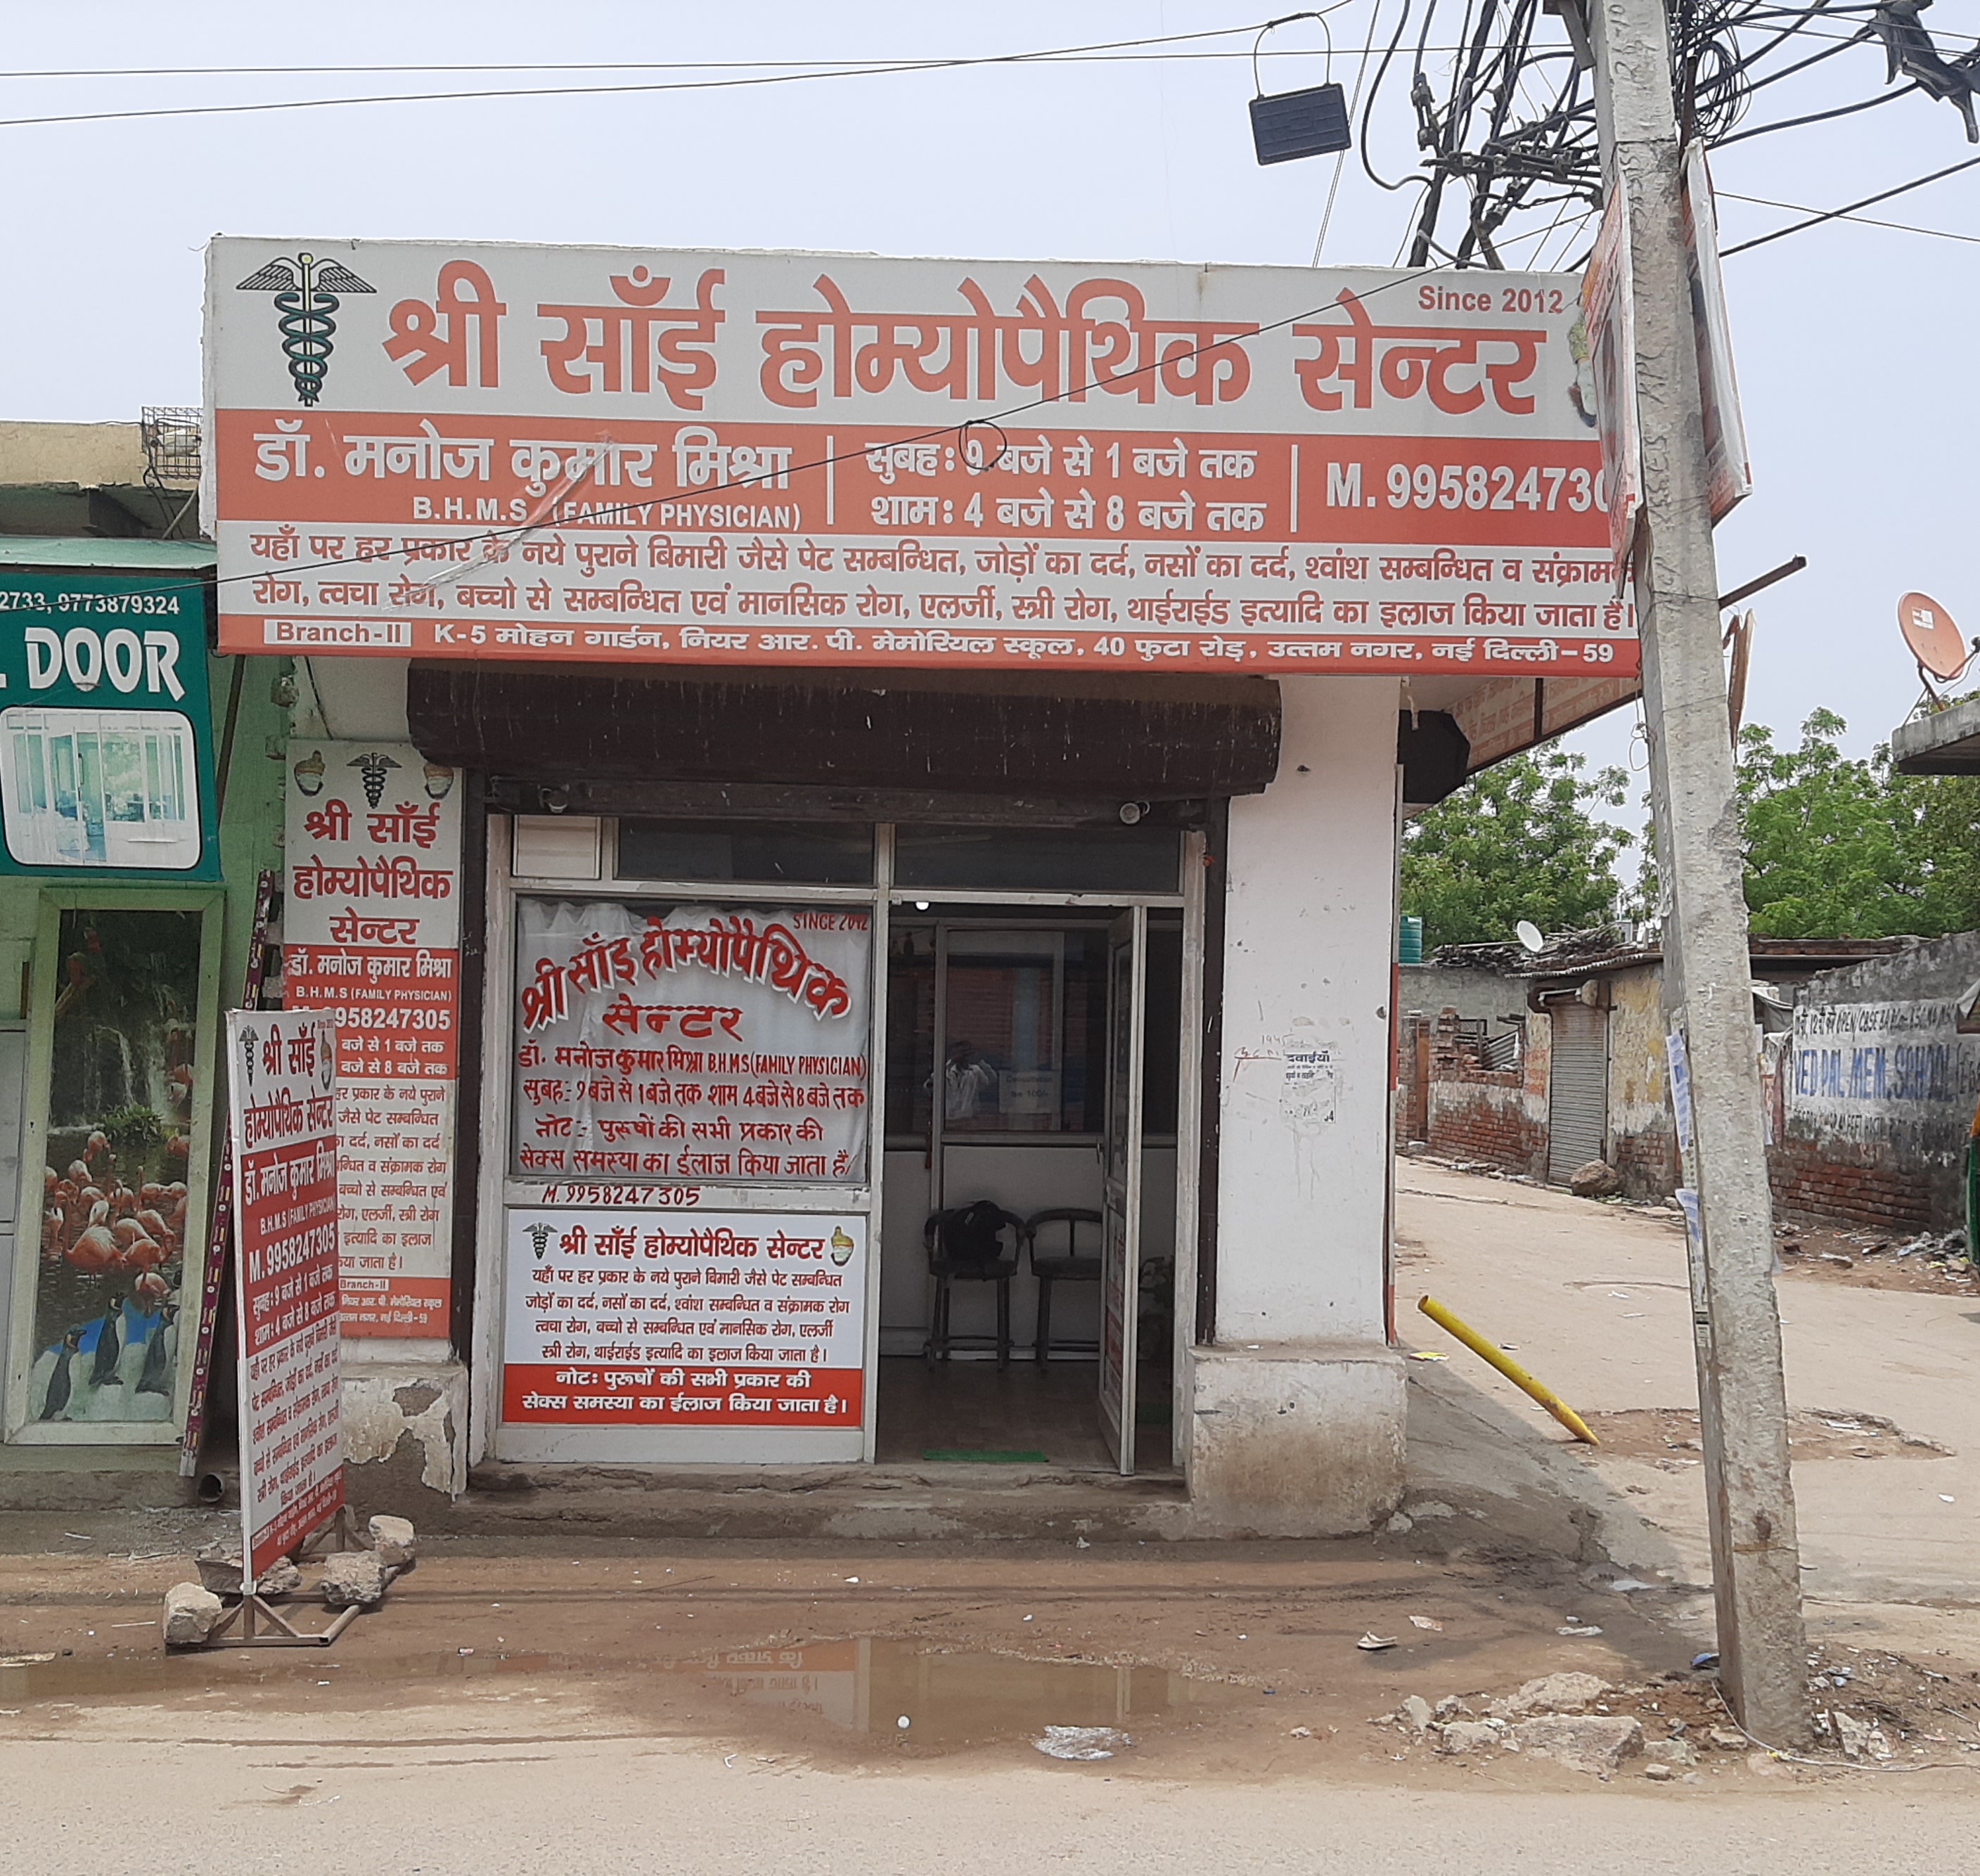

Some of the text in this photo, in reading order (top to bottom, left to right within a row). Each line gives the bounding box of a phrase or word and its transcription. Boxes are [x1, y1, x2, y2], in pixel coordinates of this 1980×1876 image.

[1418, 285, 1562, 314] Since 2012
[383, 261, 505, 387] श्री
[756, 276, 1259, 408] होम्योपैथिक
[1292, 287, 1545, 414] सेन्टर
[252, 419, 792, 502] डॉ. मनोज कुमार मिश्रा
[963, 439, 986, 475] 9
[992, 435, 1052, 475] बजे
[1062, 436, 1093, 477] से
[1105, 442, 1119, 478] 1
[1131, 438, 1188, 478] बजे
[1197, 450, 1256, 479] तक
[1326, 463, 1375, 507] M.
[1386, 460, 1611, 513] 995824730
[412, 496, 799, 532] B.H.M.S (FAMILY PHYSICIAN)
[963, 492, 984, 527] 4
[995, 488, 1054, 528] बजे
[1063, 489, 1095, 529] से
[1106, 495, 1124, 532] 8
[1137, 491, 1195, 531] बजे
[1205, 502, 1266, 532] तक
[249, 525, 298, 561] यहाँ
[309, 537, 345, 560] पर
[354, 537, 390, 563] हर
[401, 539, 471, 564] प्रकार
[522, 534, 565, 565] नये
[574, 537, 637, 577] पुराने
[648, 534, 726, 569] बिमारी
[737, 538, 787, 570] जैसे
[797, 540, 832, 571] पेट
[842, 539, 965, 573] सम्बन्धित,
[1045, 552, 1079, 574] का
[1091, 544, 1134, 576] दर्द,
[1145, 547, 1200, 577] नसों
[1206, 555, 1241, 576] का
[1250, 546, 1294, 579] दर्द,
[1380, 548, 1492, 581] सम्बन्धित
[1503, 560, 1521, 581] व
[56, 593, 179, 614] 9773879324
[253, 574, 308, 605] रोग,
[318, 582, 378, 605] त्वचा
[388, 575, 443, 608] रोग,
[457, 579, 515, 608] बच्चो
[527, 579, 550, 610] से
[564, 579, 679, 612] सम्बन्धित
[690, 584, 730, 615] एवं
[738, 583, 847, 616] मानसिक
[856, 586, 908, 617] रोग,
[919, 585, 1001, 619] एलर्जी,
[1012, 586, 1053, 619] स्त्री
[1064, 589, 1117, 621] रोग,
[1127, 589, 1228, 626] थाईराईड
[1240, 591, 1323, 626] इत्यादि
[1333, 601, 1368, 622] का
[1380, 602, 1454, 628] इलाज
[1463, 593, 1525, 624] किया
[1534, 605, 1595, 627] जाता
[276, 622, 399, 641] Branch-II
[433, 624, 486, 644] K-5
[494, 624, 573, 647] मोहन
[579, 622, 672, 649] गार्डन,
[674, 622, 750, 650] नियर
[757, 634, 817, 650] आर.
[822, 625, 863, 650] पी.
[1093, 637, 1125, 656] 40
[1134, 640, 1190, 662] फुटा
[1267, 641, 1342, 657] उत्तम
[1349, 643, 1422, 660] नगर,
[1428, 635, 1474, 662] नई
[25, 627, 185, 701] DOOR
[304, 799, 352, 841] श्री
[292, 854, 454, 899] होम्योपैथिक
[329, 906, 420, 944] सेन्टर
[296, 987, 451, 1002] B.H.M.S (FAMILY PHYSICIAN)
[335, 1008, 451, 1030] 958247305
[603, 993, 744, 1042] सेन्टर
[541, 1186, 700, 1206] M. 9958247305
[249, 1222, 335, 1283] M. 9958247305
[559, 1225, 587, 1254] श्री
[644, 1227, 759, 1259] होम्योपैथिक
[766, 1230, 825, 1259] सेन्टर
